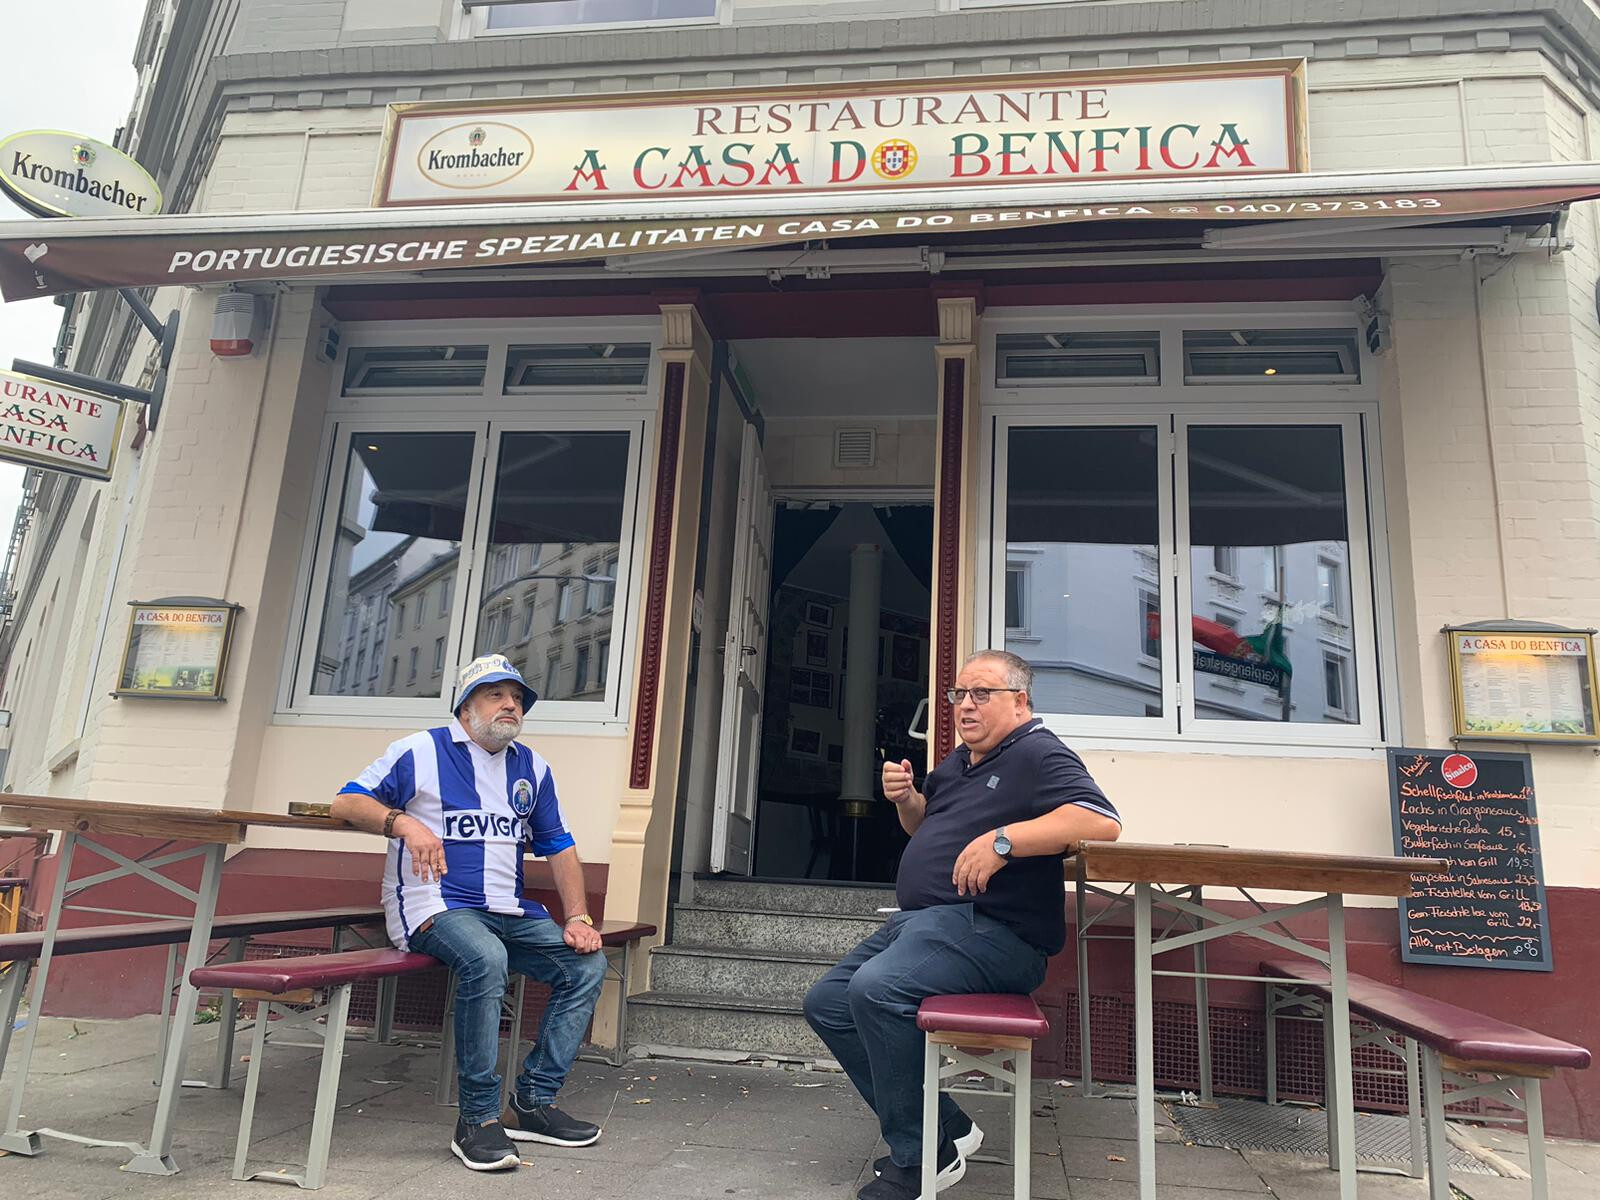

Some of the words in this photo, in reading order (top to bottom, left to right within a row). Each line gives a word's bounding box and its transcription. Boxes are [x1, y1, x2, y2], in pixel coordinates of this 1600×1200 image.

[692, 88, 1111, 137] RESTAURANTE
[428, 147, 524, 171] Krombacher
[563, 149, 609, 192] A
[632, 142, 804, 190] CASA
[949, 123, 1258, 178] BENFICA
[12, 151, 147, 212] Krombacher
[168, 240, 464, 274] PORTUGIESISCHE
[777, 218, 880, 236] CASA
[895, 215, 953, 228] DO
[970, 206, 1153, 223] BENFICA
[1215, 198, 1442, 215] 040/373183
[4, 381, 102, 418] URANTE
[0, 401, 69, 433] ASA
[0, 424, 98, 462] NFICA
[138, 612, 145, 621] A
[147, 613, 169, 622] CASA
[172, 613, 184, 622] DO
[186, 613, 222, 623] BENFICA
[1463, 639, 1471, 649] A
[1474, 639, 1506, 650] CASA
[1511, 640, 1526, 651] DO
[1530, 640, 1581, 652] BENFICA
[1445, 762, 1473, 781] Sinalco
[1437, 806, 1448, 815] in
[1499, 889, 1530, 901] Grill
[1486, 918, 1515, 928] Grill
